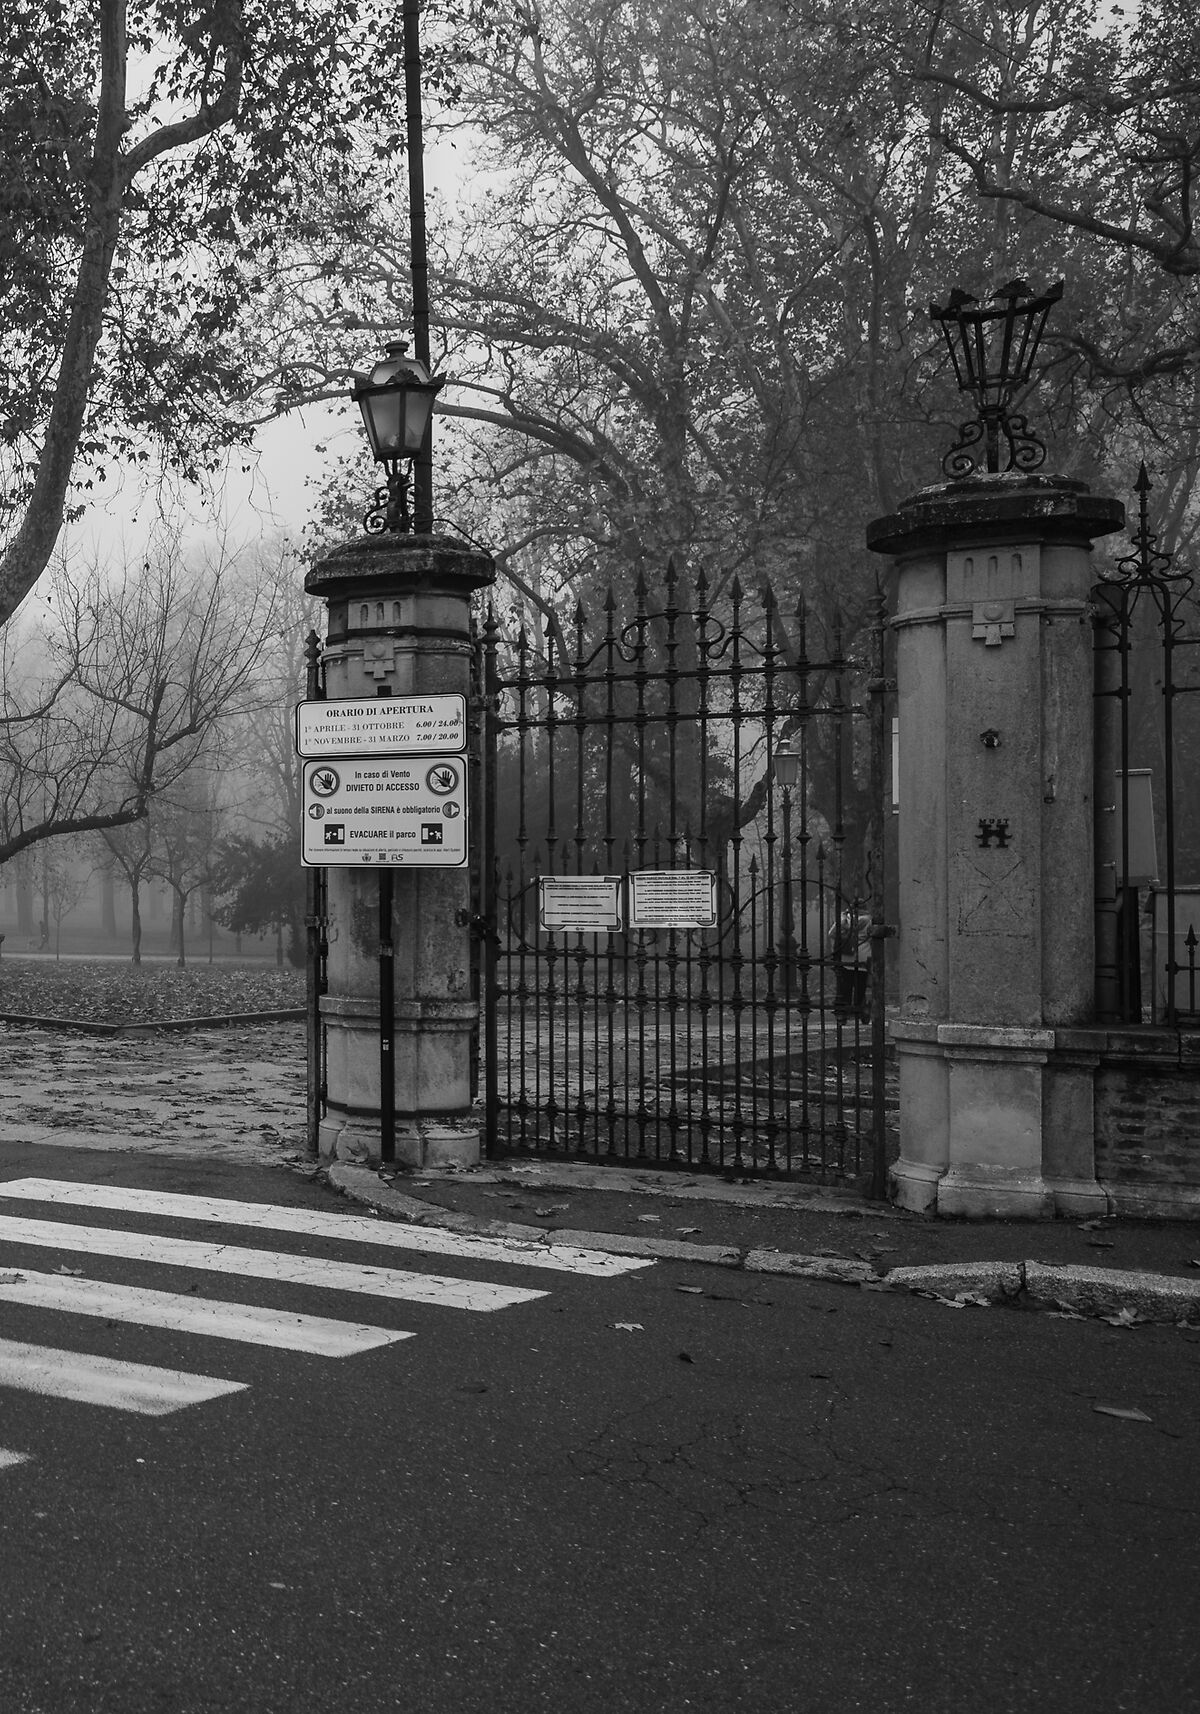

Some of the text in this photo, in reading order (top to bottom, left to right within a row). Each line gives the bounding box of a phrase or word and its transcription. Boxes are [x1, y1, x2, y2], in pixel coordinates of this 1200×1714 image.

[326, 705, 434, 718] ORARIO DI APERTURA
[314, 724, 346, 733] APRILE
[362, 722, 405, 730] OTTOBRE
[314, 736, 362, 746] NOVEMBRE
[379, 734, 410, 742] MARZO
[354, 771, 362, 779] In
[382, 770, 389, 778] di
[390, 770, 411, 778] Vento
[346, 782, 420, 792] DIVIETO DI ACCESSO
[354, 806, 369, 814] della
[370, 806, 395, 814] SIRENA
[396, 806, 400, 814] è
[402, 804, 441, 815] obbligatorio
[350, 830, 416, 840] EVACUARE il parco
